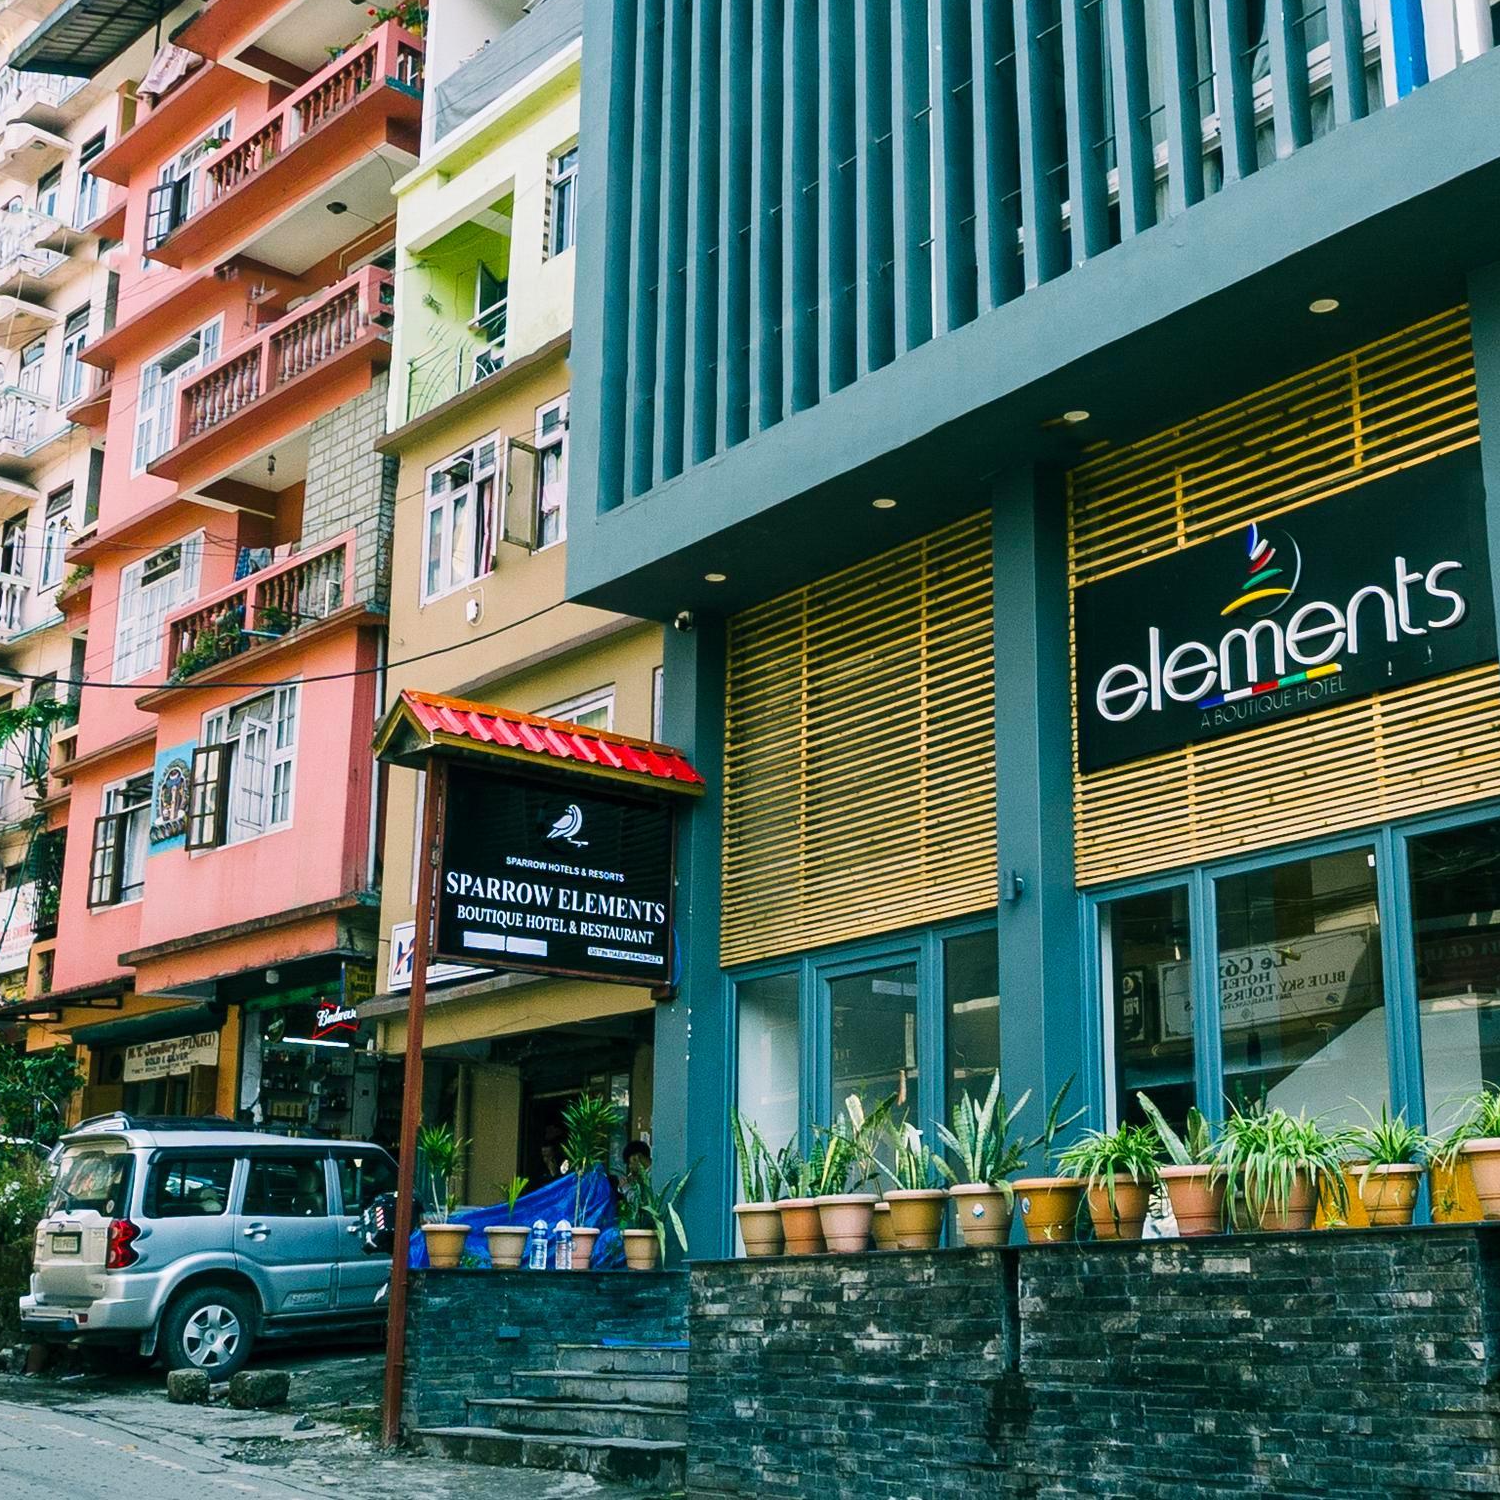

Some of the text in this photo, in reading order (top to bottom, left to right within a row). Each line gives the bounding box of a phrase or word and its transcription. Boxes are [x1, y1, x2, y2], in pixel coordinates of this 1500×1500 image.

[1095, 555, 1467, 723] elements
[1215, 689, 1292, 728] BOUTIQUE
[1296, 675, 1347, 703] HOTEL
[506, 856, 625, 882] SPARROW HOTELS & RESORTS
[446, 871, 665, 924] SPARROW ELEMENTS
[457, 904, 654, 945] BOUTIQUE HOTEL & RESTAURANT
